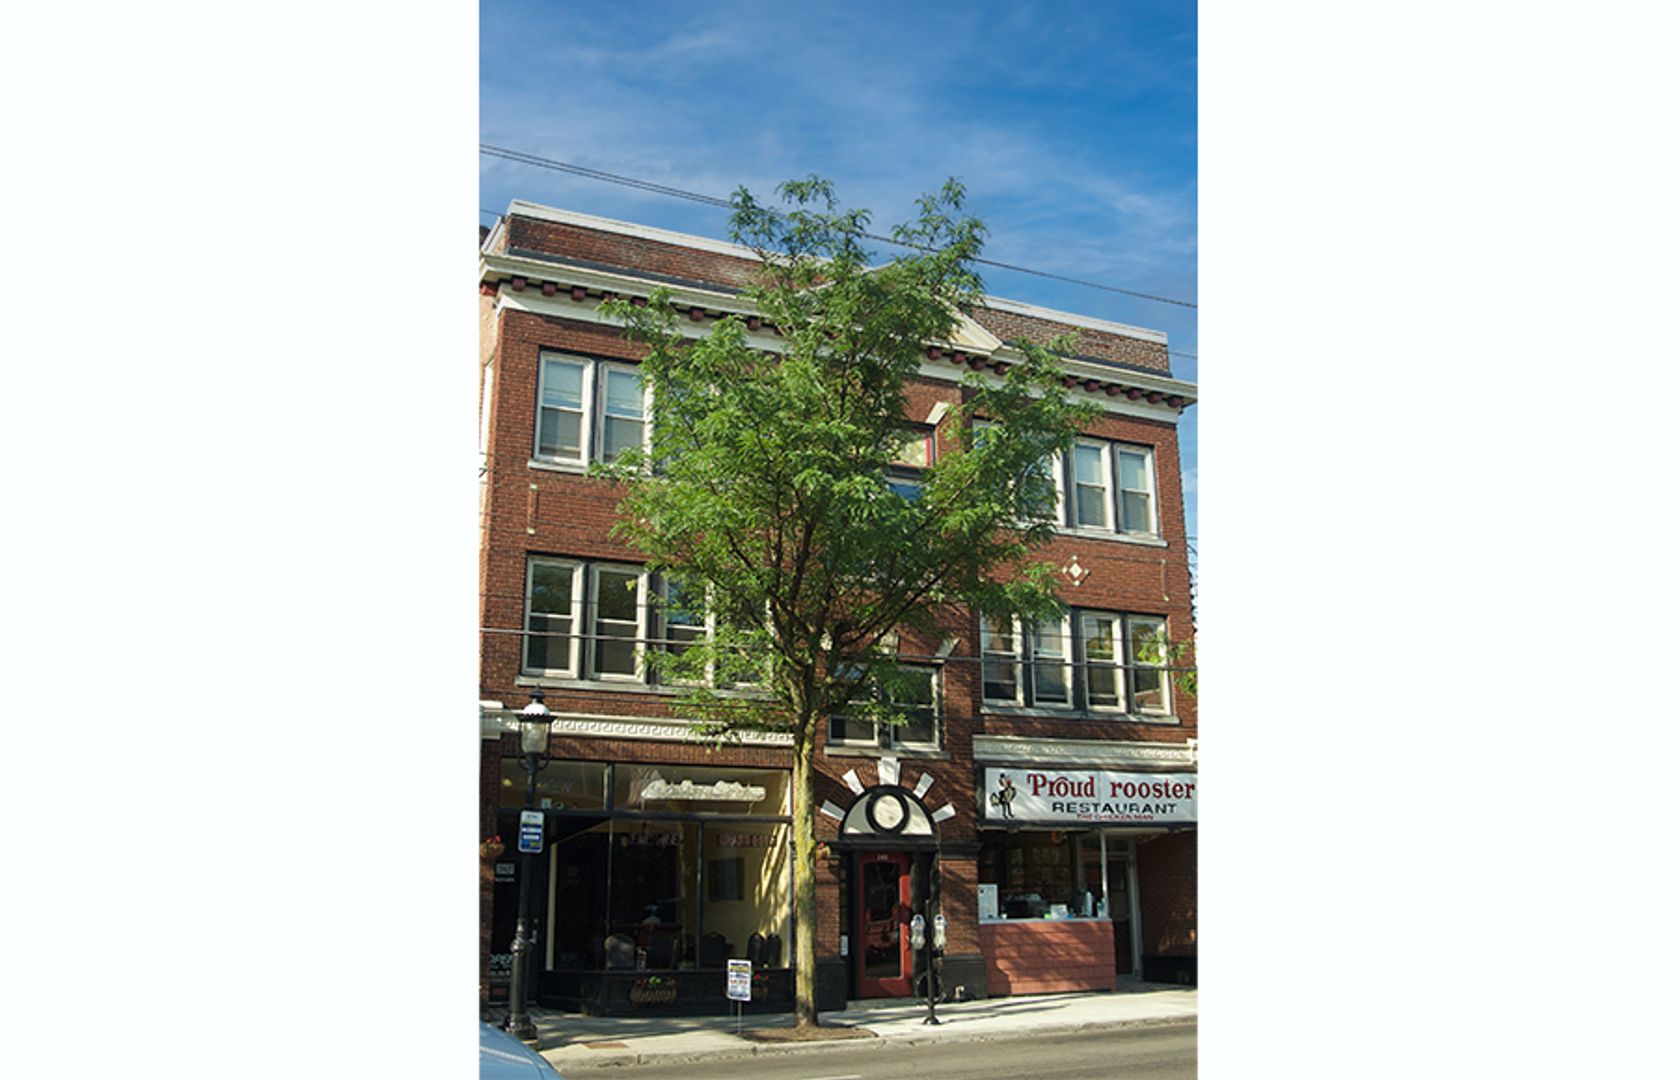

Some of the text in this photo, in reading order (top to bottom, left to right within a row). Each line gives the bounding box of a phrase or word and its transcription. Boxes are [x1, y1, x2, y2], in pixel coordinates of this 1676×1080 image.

[1026, 773, 1196, 799] Proud rooster
[1052, 802, 1178, 814] RESTAURANT
